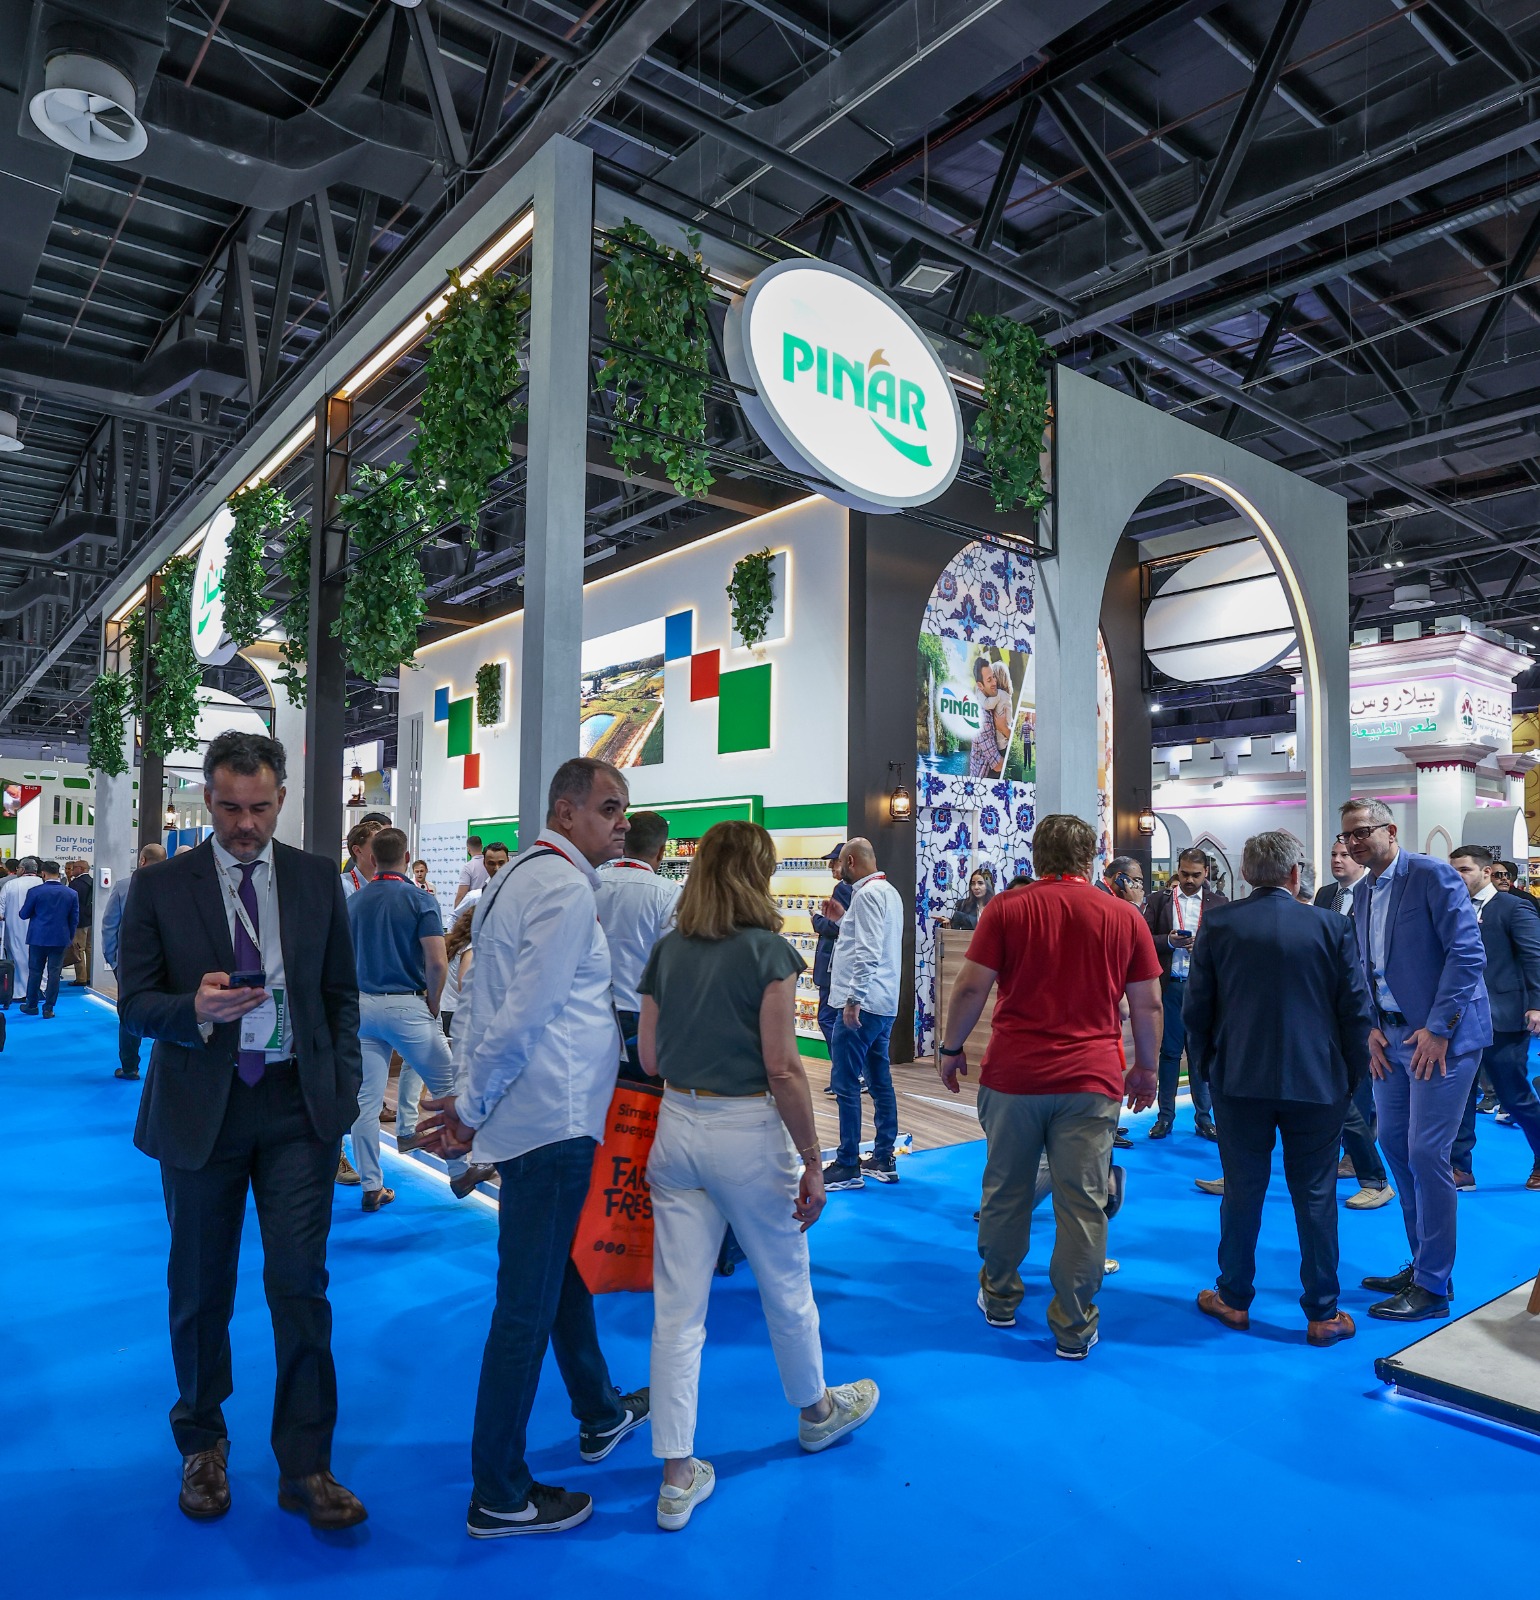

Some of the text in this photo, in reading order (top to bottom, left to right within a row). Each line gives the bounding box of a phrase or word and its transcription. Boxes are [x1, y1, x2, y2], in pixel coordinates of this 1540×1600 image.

[1477, 698, 1512, 722] BELARUS
[1408, 717, 1437, 741] طعم
[55, 835, 78, 845] Dairy
[55, 844, 93, 853] For Food
[603, 1187, 654, 1221] FRES
